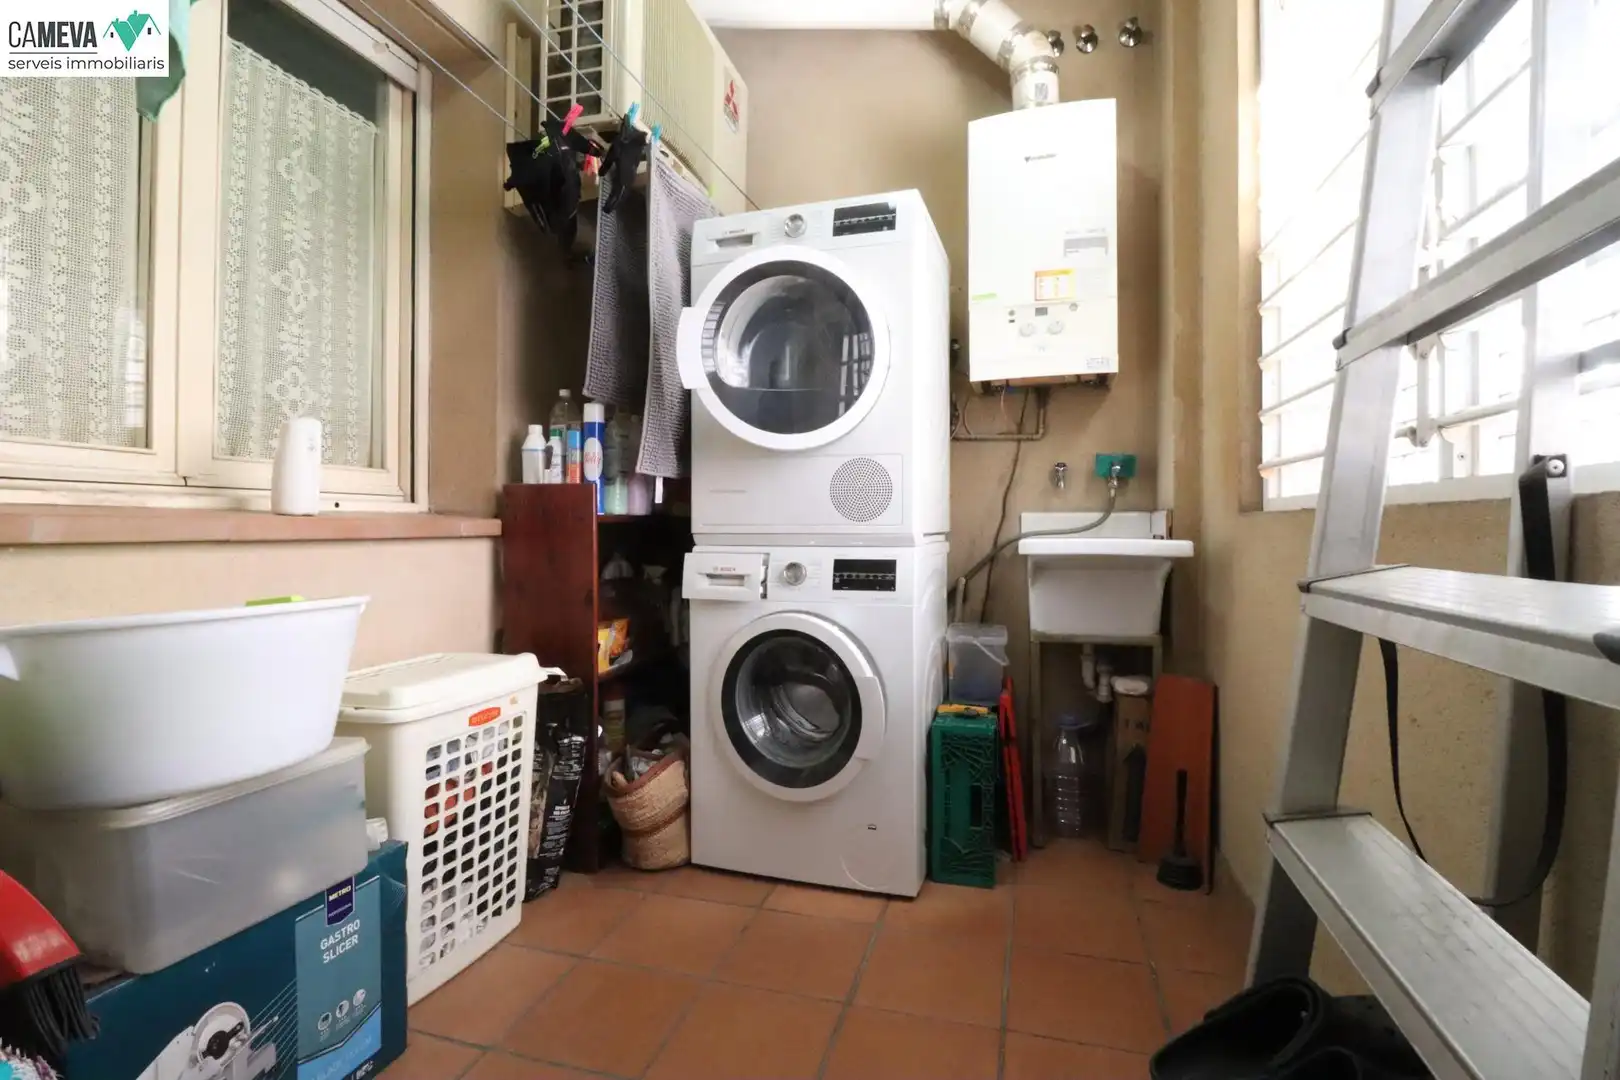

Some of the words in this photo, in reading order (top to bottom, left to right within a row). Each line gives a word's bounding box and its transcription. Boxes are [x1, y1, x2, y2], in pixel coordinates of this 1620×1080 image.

[328, 885, 352, 901] METRO
[320, 919, 360, 950] GASTRO
[322, 934, 359, 964] SLICER
